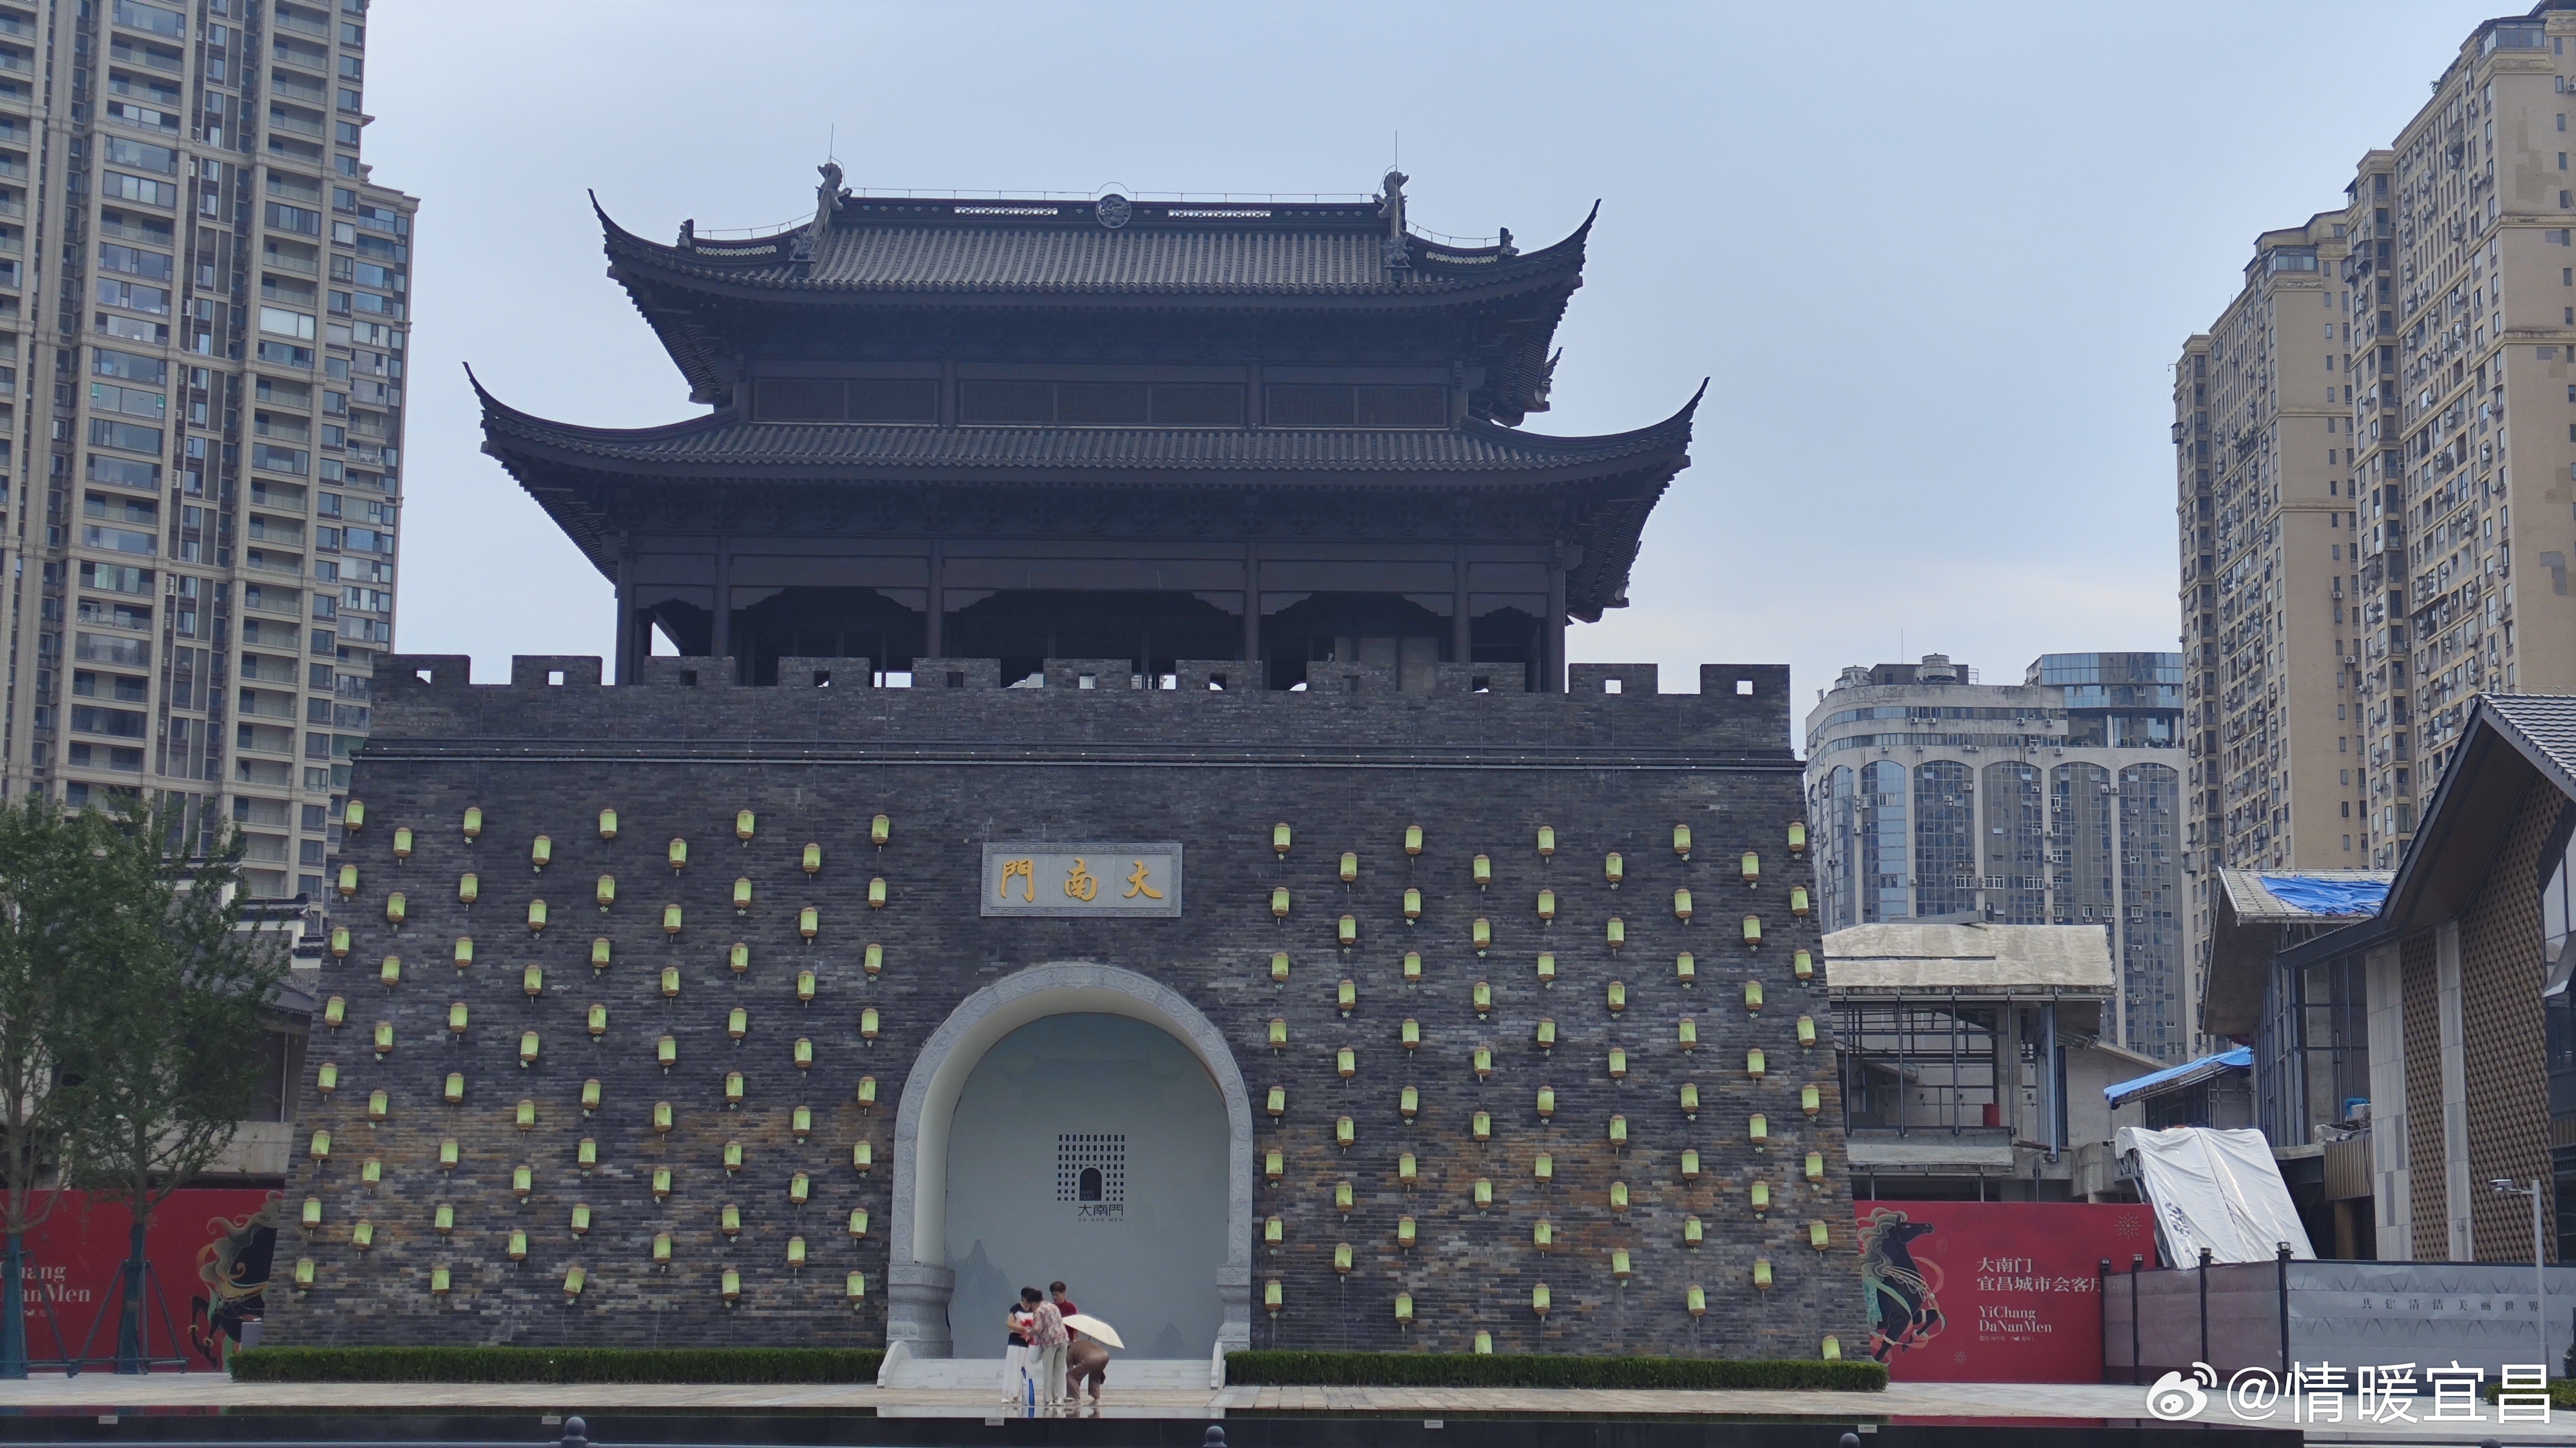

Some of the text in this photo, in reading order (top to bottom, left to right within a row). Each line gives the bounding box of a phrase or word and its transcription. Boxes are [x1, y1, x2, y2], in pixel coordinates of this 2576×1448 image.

[1078, 1204, 1123, 1216] 大南門
[1977, 1256, 2032, 1273] 大南门
[1979, 1305, 2036, 1320] YiChang
[2362, 1298, 2539, 1313] 共建清洁美丽世界
[1979, 1319, 2052, 1333] DaNanMen
